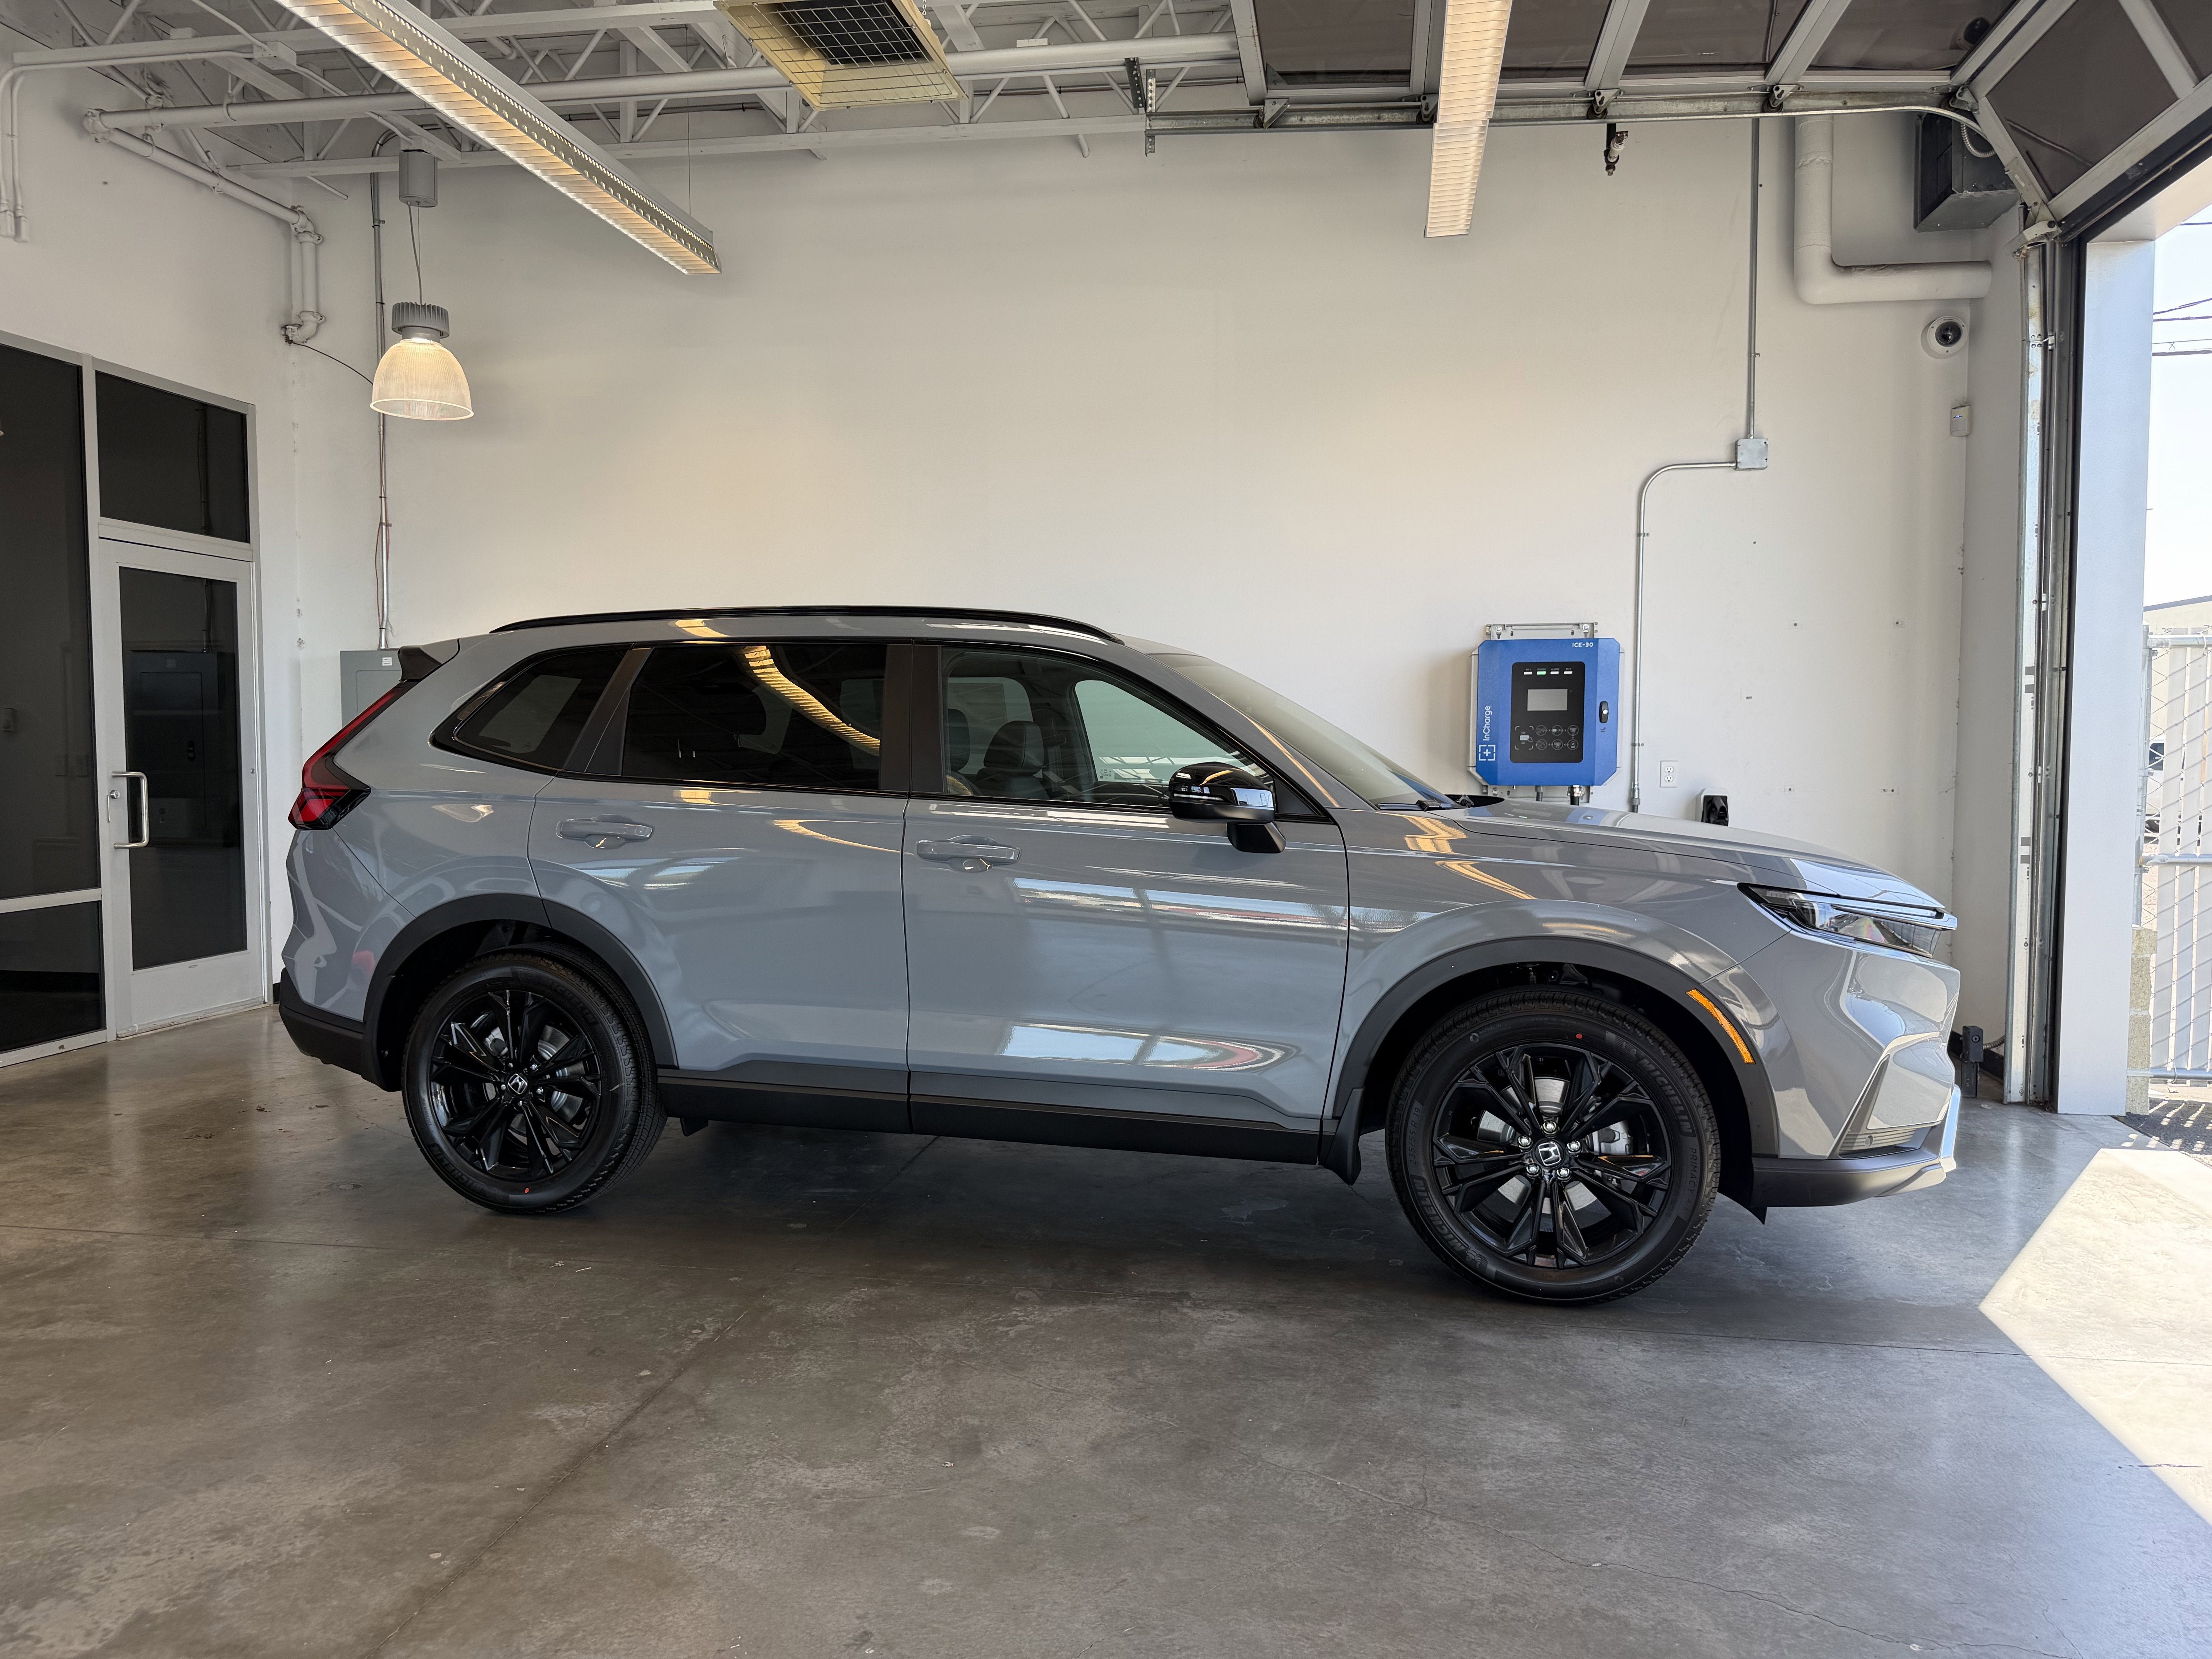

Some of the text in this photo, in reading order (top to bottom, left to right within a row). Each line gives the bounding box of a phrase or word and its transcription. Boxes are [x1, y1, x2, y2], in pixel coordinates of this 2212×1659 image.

[1482, 706, 1492, 741] InCharge
[1638, 1058, 1692, 1133] MICHELIN
[1408, 1130, 1417, 1165] 235/55
[1413, 1107, 1420, 1117] 19
[1687, 1147, 1698, 1195] PRIMACY
[1413, 1178, 1466, 1252] MICHELIN
